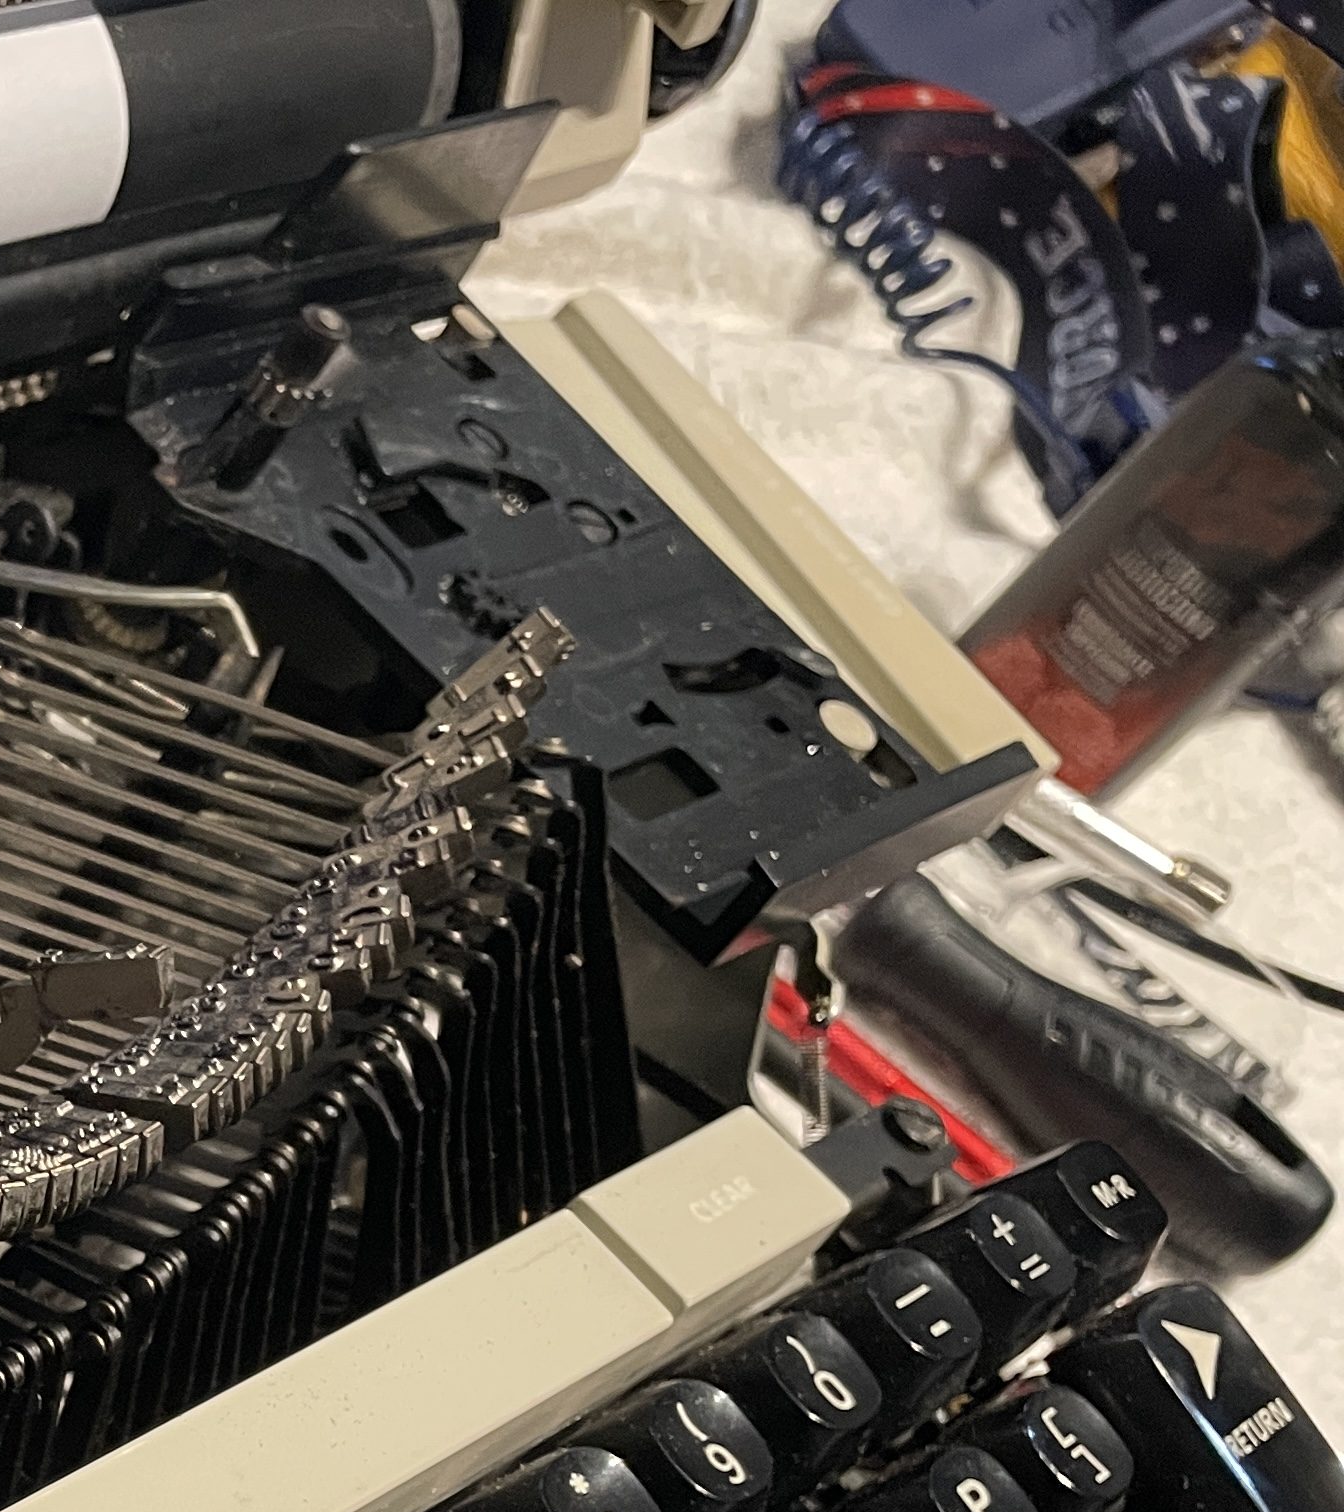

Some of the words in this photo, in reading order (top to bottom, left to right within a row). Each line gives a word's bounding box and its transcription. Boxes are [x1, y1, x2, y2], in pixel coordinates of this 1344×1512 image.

[687, 1174, 756, 1224] CLEAR
[812, 1369, 855, 1411] 0
[1224, 1396, 1296, 1460] RETURN
[703, 1443, 746, 1485] 9
